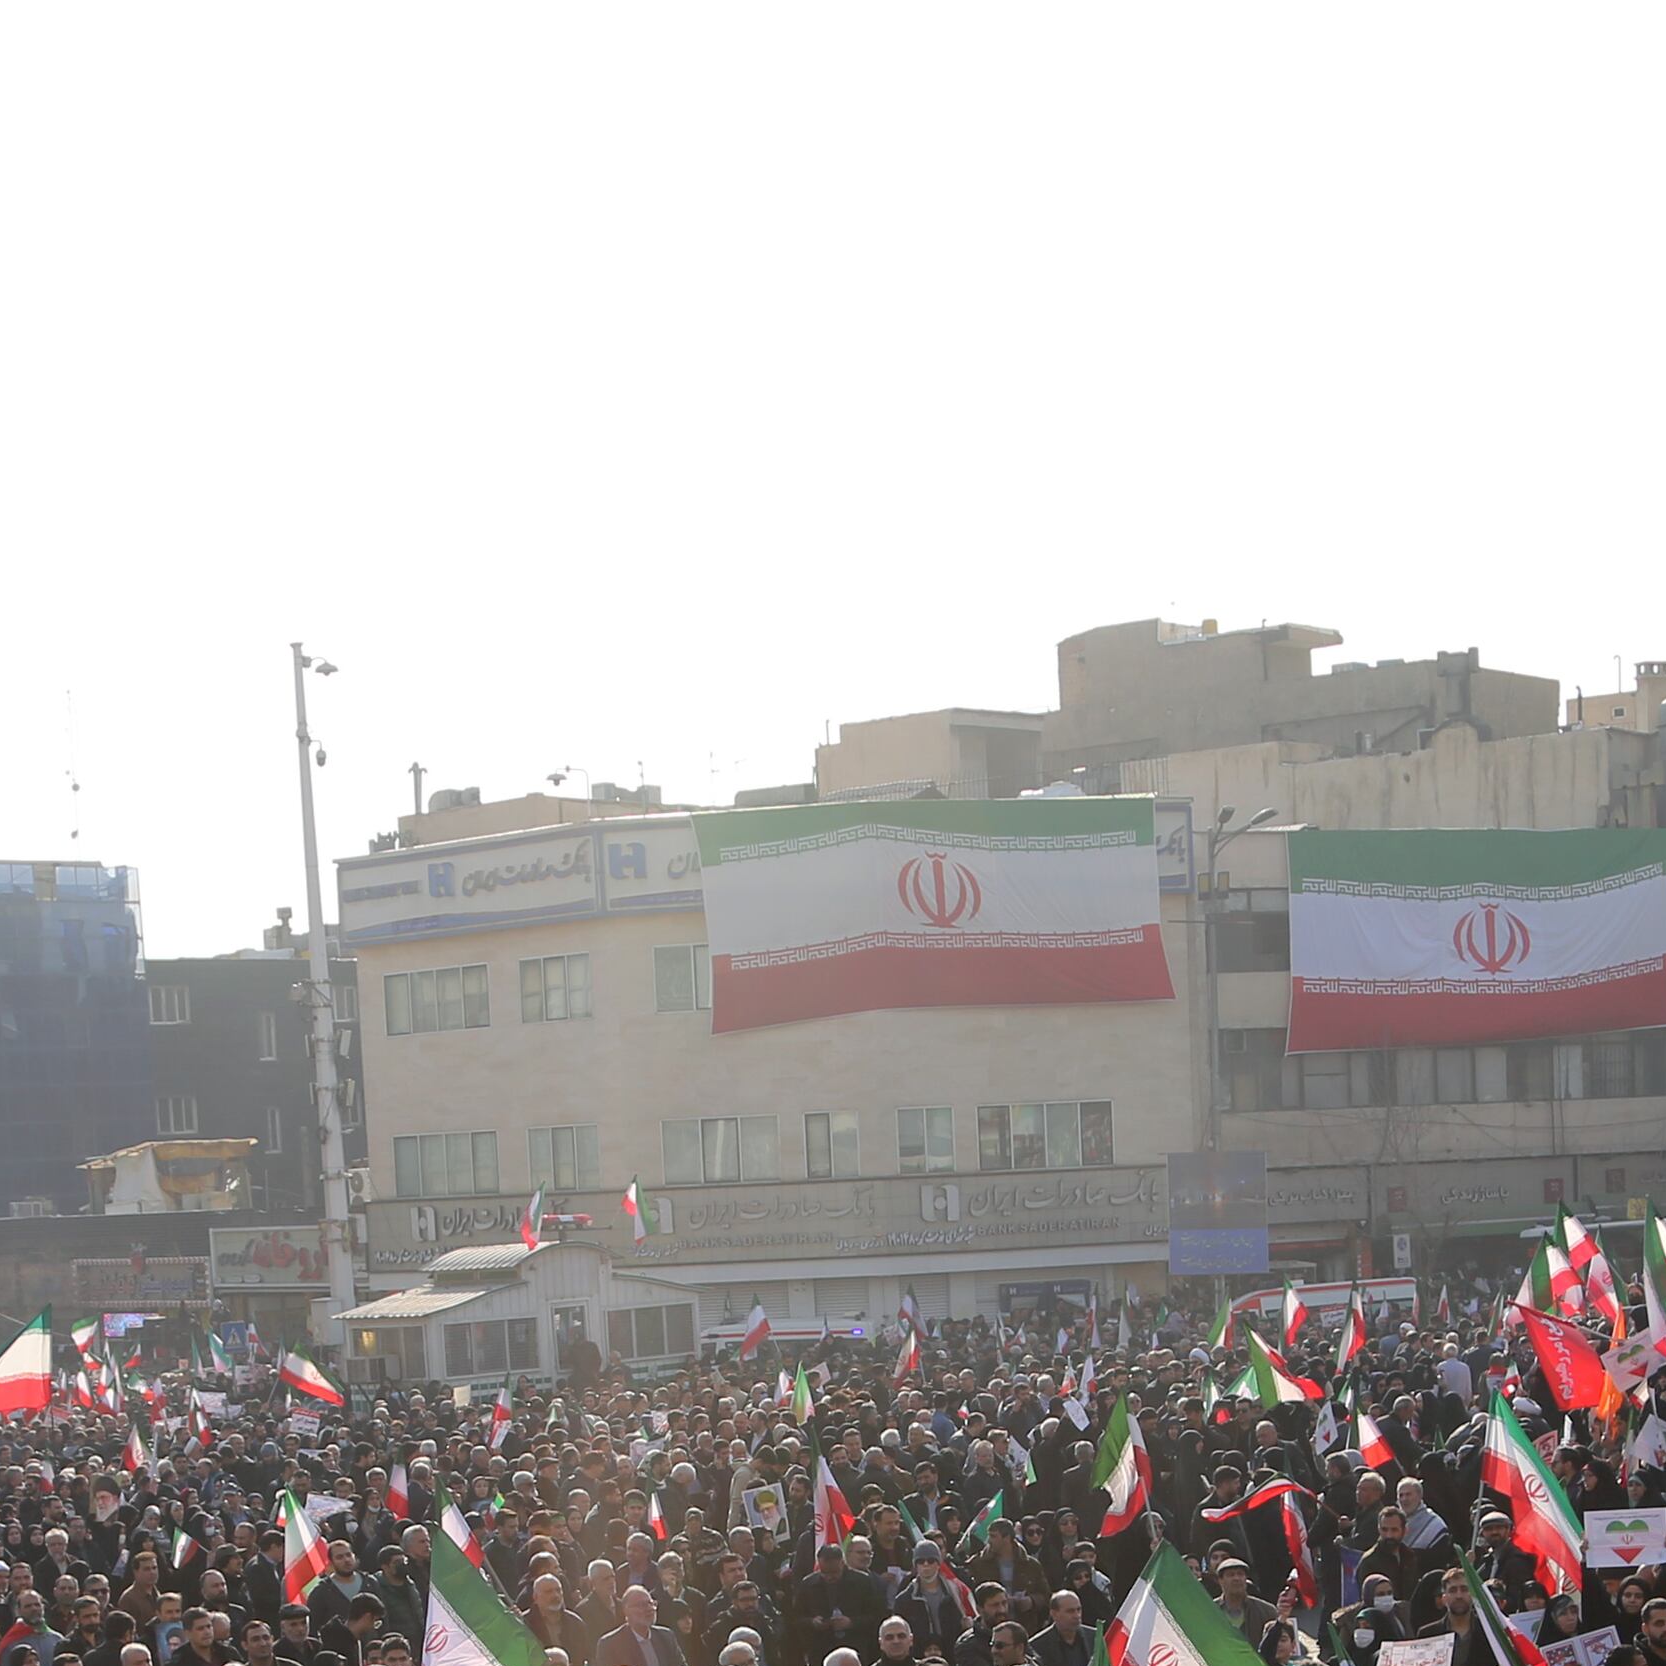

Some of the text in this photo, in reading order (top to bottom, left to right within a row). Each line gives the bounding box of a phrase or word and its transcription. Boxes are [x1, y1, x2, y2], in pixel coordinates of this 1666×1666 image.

[689, 1185, 874, 1230] بانک صادرات ایران
[969, 1169, 1158, 1217] بانک صادرات ایران
[442, 1206, 474, 1237] ایران
[976, 1223, 1015, 1236] BANK
